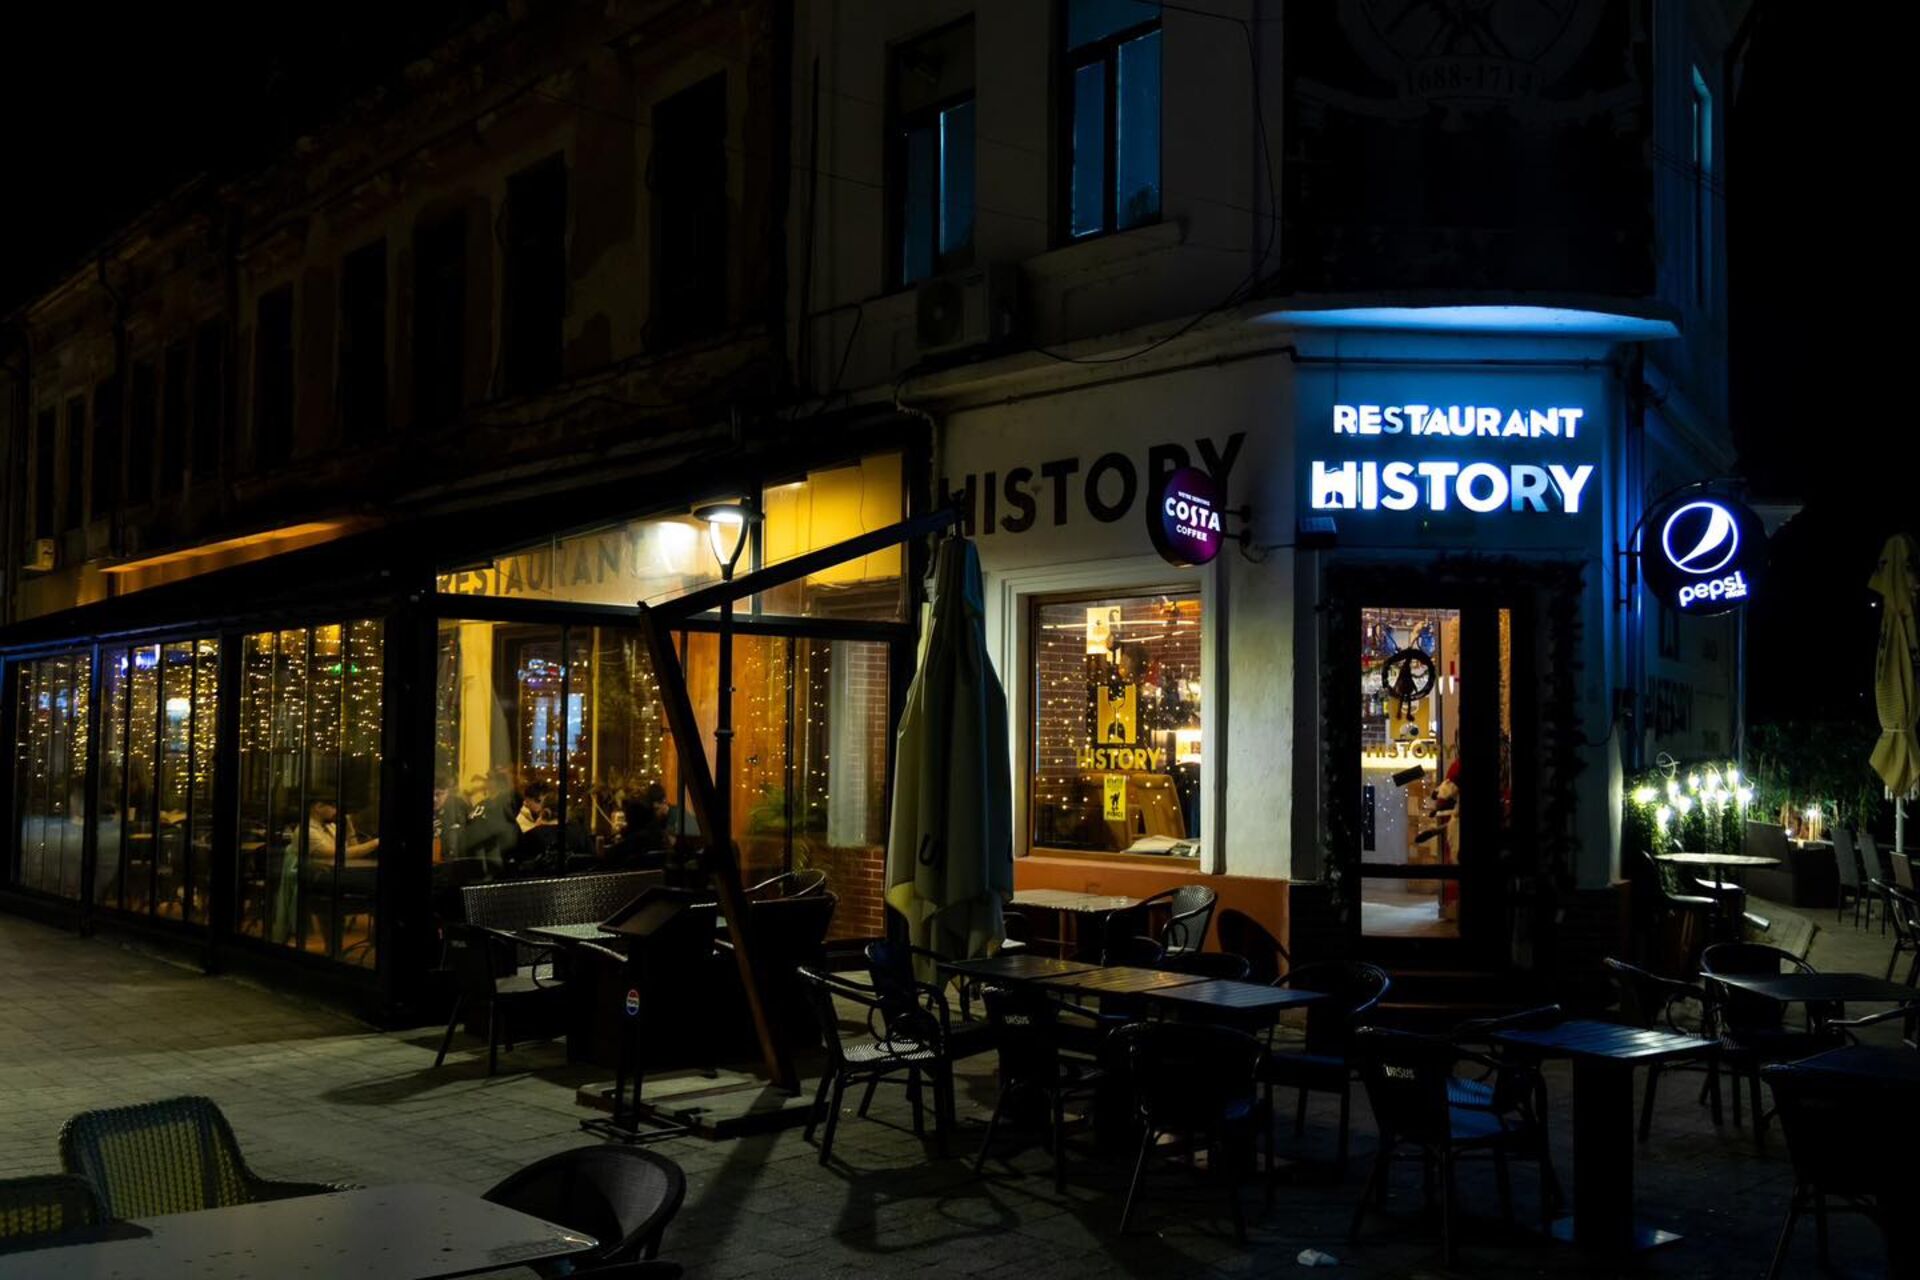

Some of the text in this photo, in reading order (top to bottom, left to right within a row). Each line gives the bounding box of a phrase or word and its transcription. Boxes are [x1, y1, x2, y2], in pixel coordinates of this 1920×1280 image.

[1332, 404, 1584, 439] RESTAURANT
[1311, 460, 1595, 514] HISTORY
[1165, 497, 1221, 532] COSTA
[1175, 524, 1208, 542] COFFEE
[1678, 571, 1744, 608] pepsi
[1076, 747, 1161, 770] HISTORY
